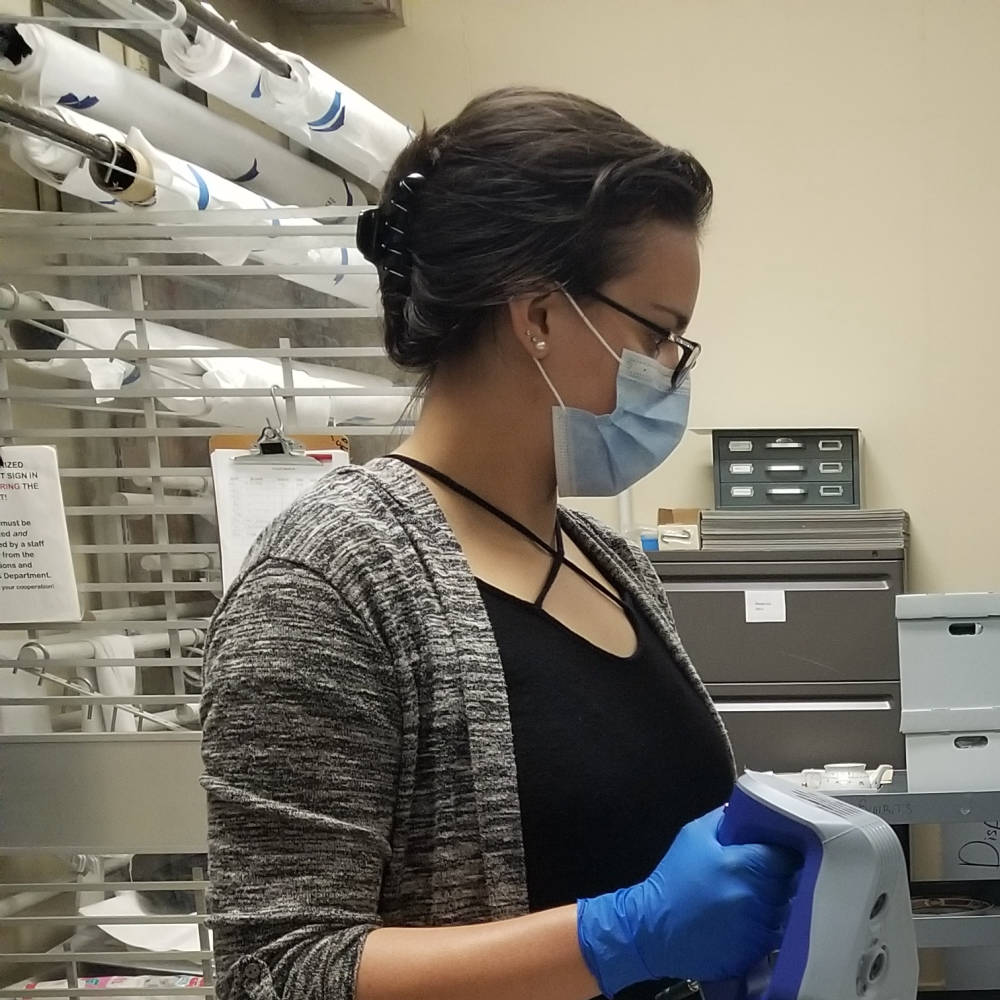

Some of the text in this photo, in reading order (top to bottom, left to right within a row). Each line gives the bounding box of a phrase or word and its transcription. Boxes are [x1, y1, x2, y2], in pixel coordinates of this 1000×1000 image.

[9, 541, 19, 549] by
[27, 540, 45, 548] staff
[3, 572, 52, 580] Department.
